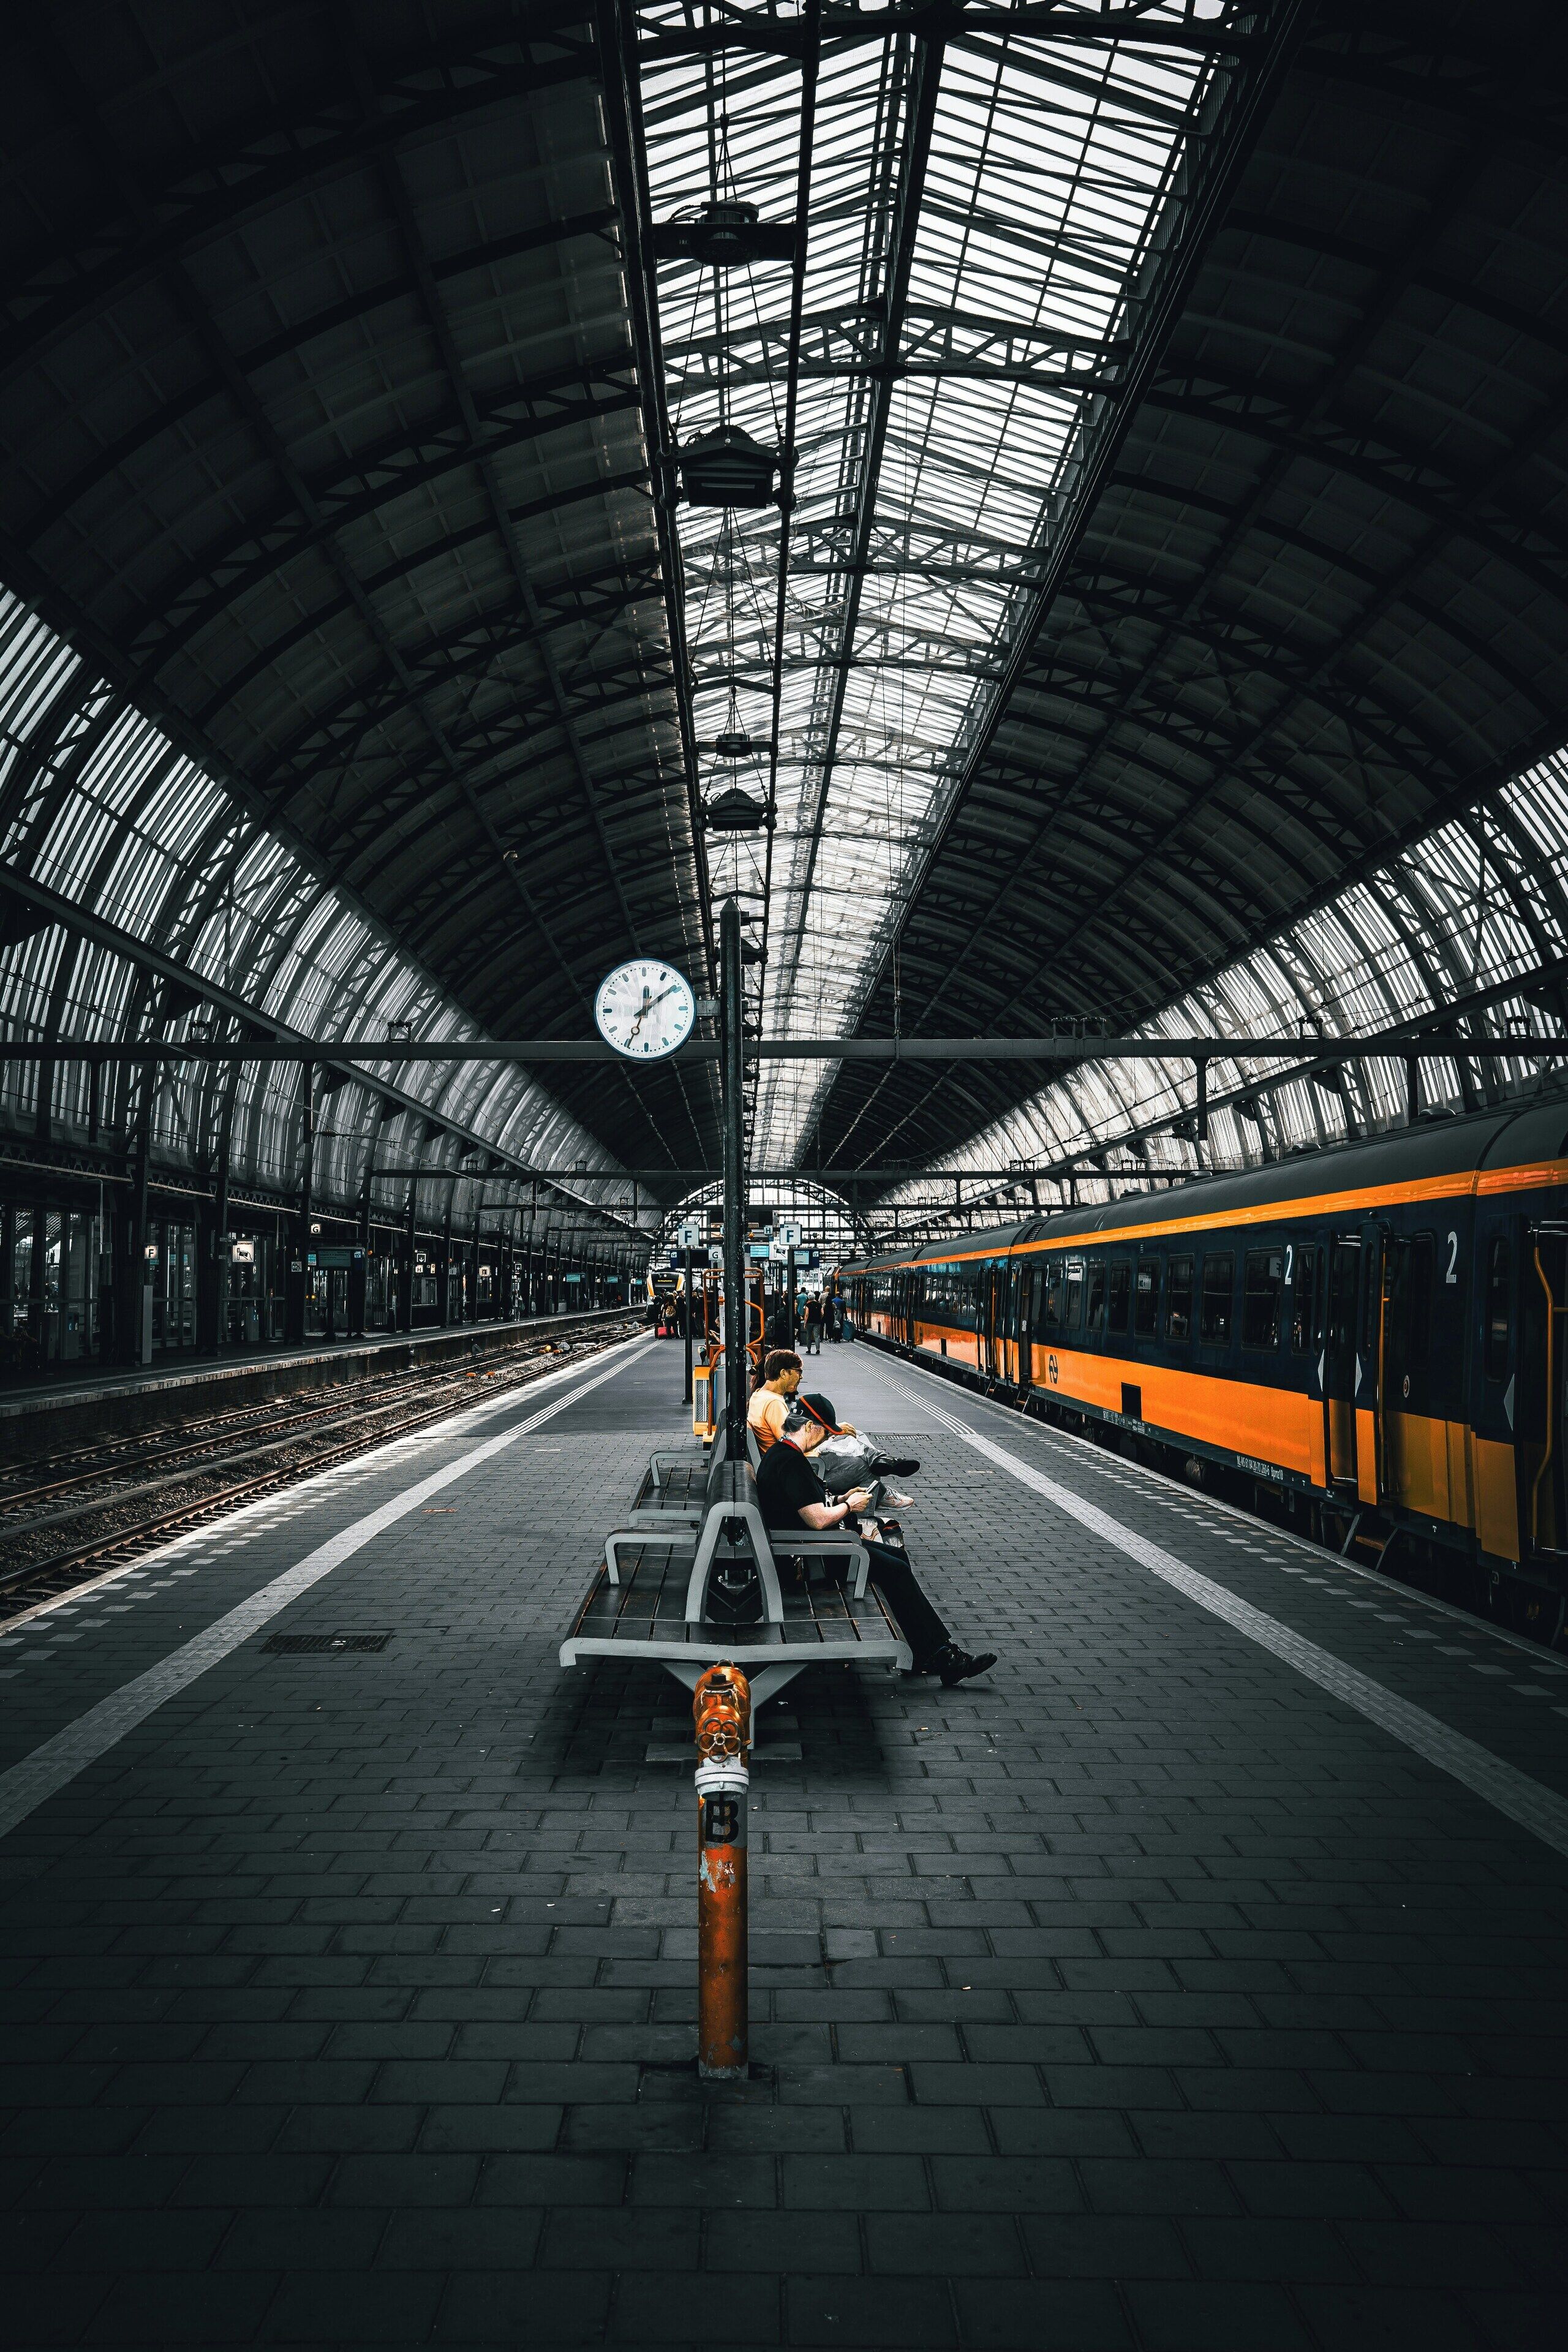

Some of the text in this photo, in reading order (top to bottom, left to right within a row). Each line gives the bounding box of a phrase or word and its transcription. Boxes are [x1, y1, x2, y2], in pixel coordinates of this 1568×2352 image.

[685, 1231, 692, 1243] F
[786, 1230, 794, 1243] F
[148, 1249, 154, 1258] F
[1284, 1245, 1292, 1284] 2
[1446, 1231, 1457, 1283] 2
[706, 1800, 739, 1844] B
